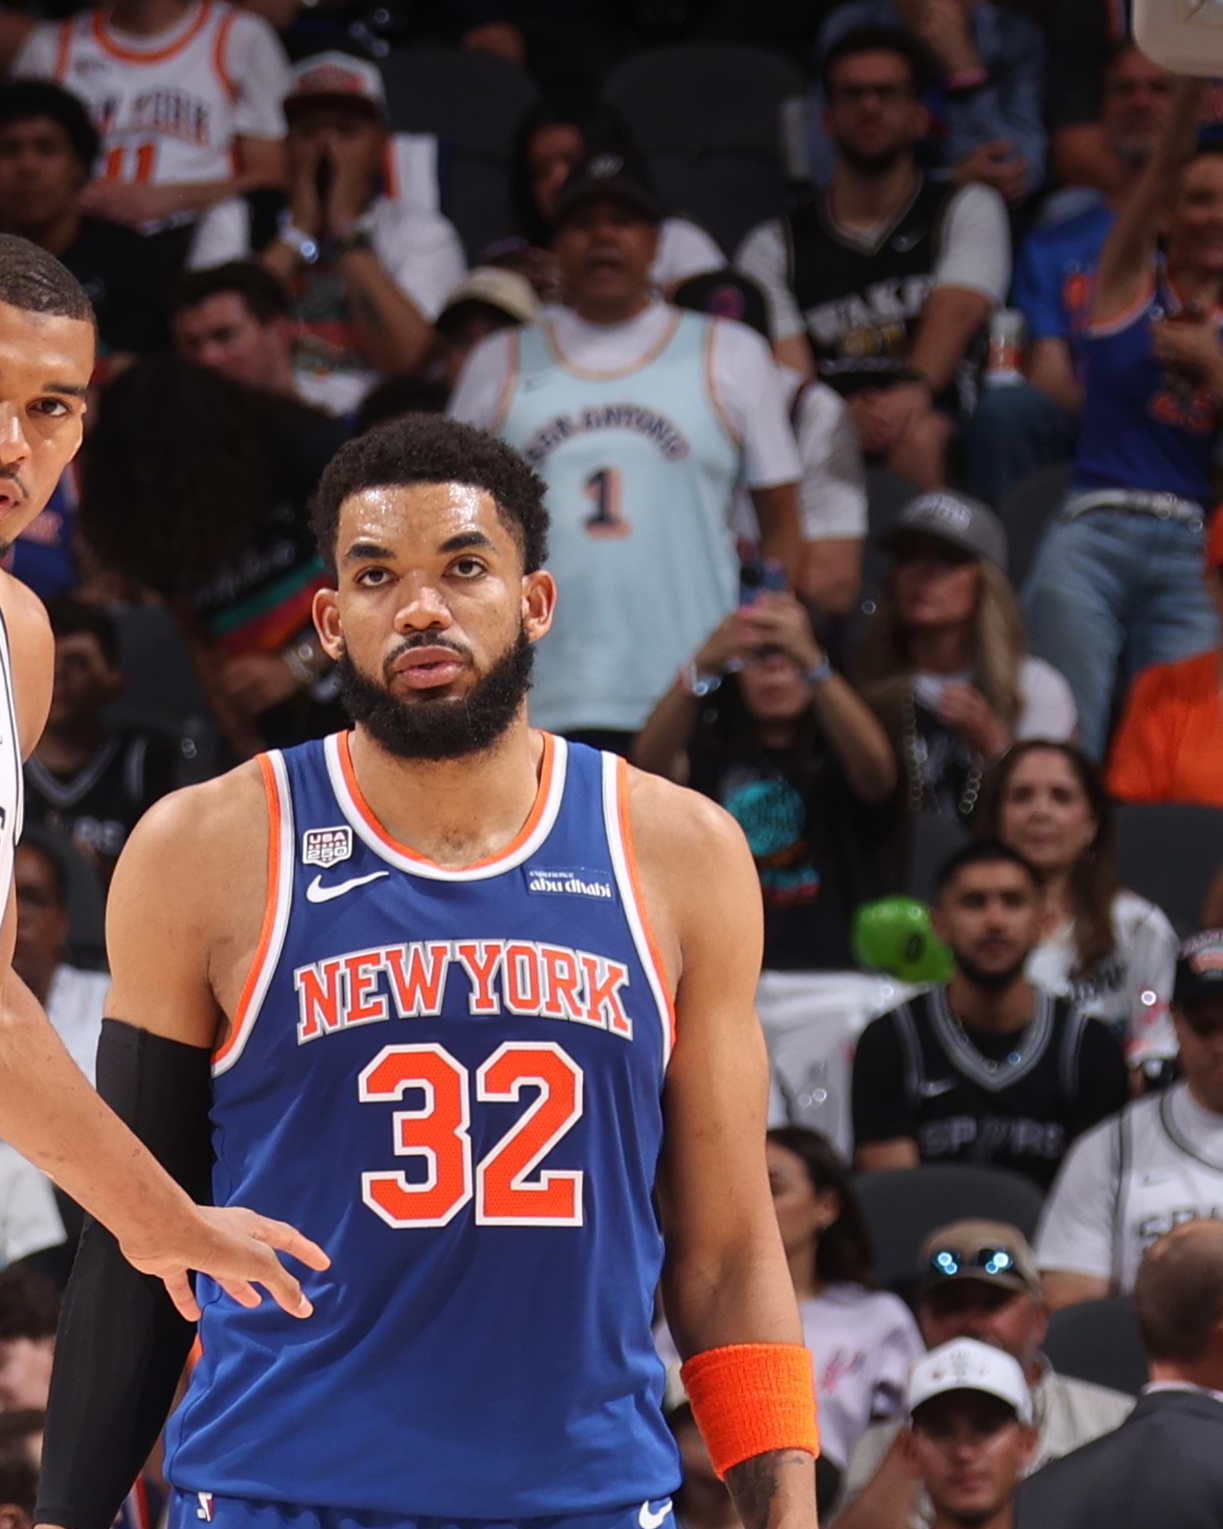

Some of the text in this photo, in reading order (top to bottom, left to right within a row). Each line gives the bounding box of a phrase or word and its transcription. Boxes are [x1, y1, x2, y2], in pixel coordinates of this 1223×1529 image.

[584, 467, 631, 539] 1
[309, 832, 345, 844] USA
[530, 878, 612, 898] abu dhabi
[294, 938, 633, 1046] NEW YORK
[358, 1041, 584, 1228] 32
